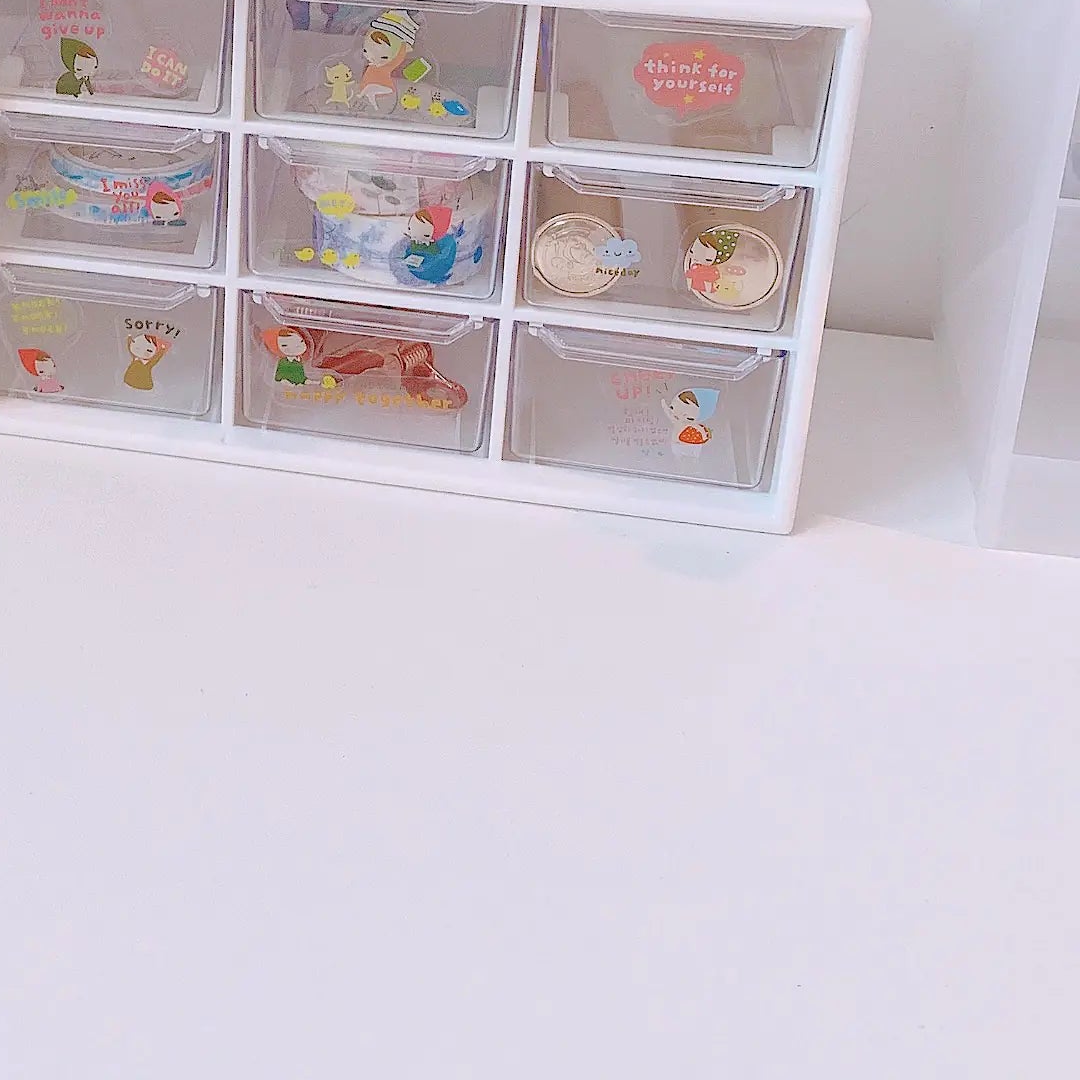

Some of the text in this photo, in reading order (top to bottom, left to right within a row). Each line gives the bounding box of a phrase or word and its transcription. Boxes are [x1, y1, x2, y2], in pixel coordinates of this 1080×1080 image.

[39, 9, 101, 21] wanna
[41, 24, 105, 40] give up
[644, 58, 738, 80] think for
[653, 77, 734, 96] yourself
[101, 177, 111, 192] I
